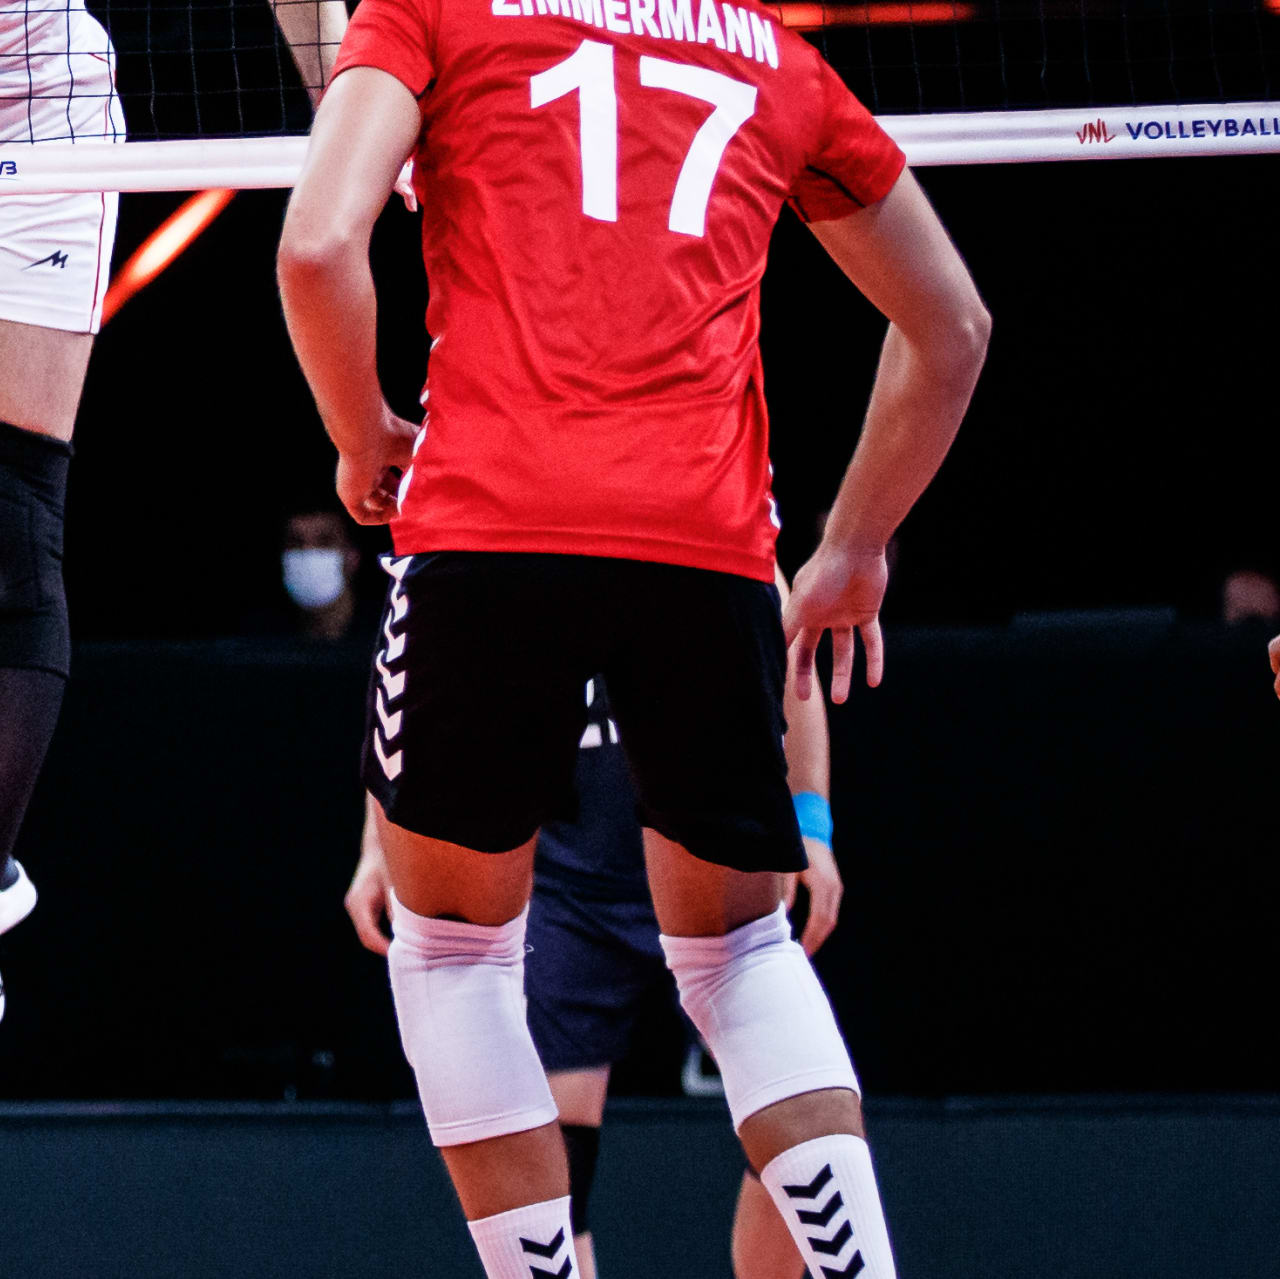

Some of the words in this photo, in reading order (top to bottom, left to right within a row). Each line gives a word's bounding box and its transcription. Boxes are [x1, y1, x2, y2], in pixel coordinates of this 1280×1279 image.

[529, 38, 759, 238] 17
[1075, 117, 1116, 145] VNL
[1126, 117, 1280, 140] VOLLEYBALL
